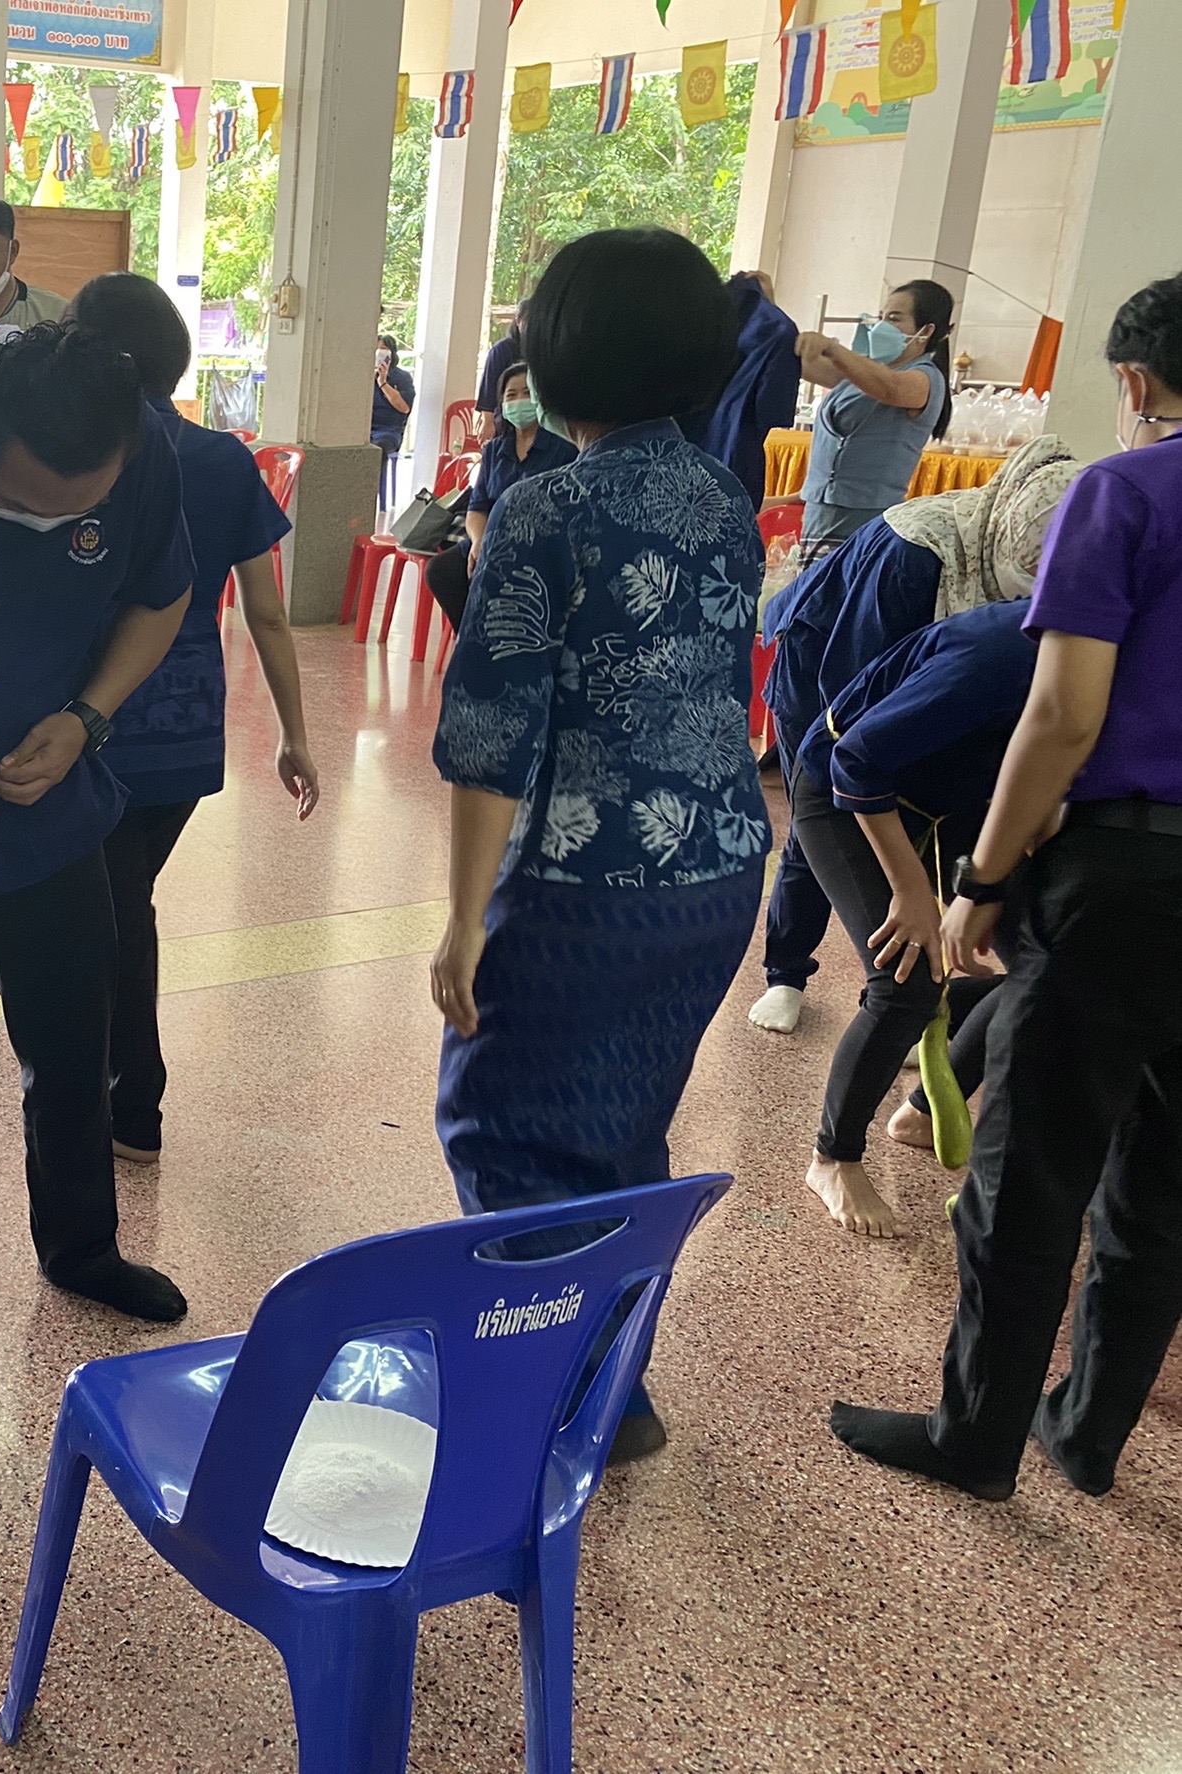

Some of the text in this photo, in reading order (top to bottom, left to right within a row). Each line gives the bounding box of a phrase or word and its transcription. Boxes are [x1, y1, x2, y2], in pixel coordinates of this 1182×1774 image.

[46, 31, 100, 46] ๑๐๐,๐๐๐
[104, 34, 129, 48] บาท
[474, 1282, 585, 1340] นรินทร์แอร์บัส
